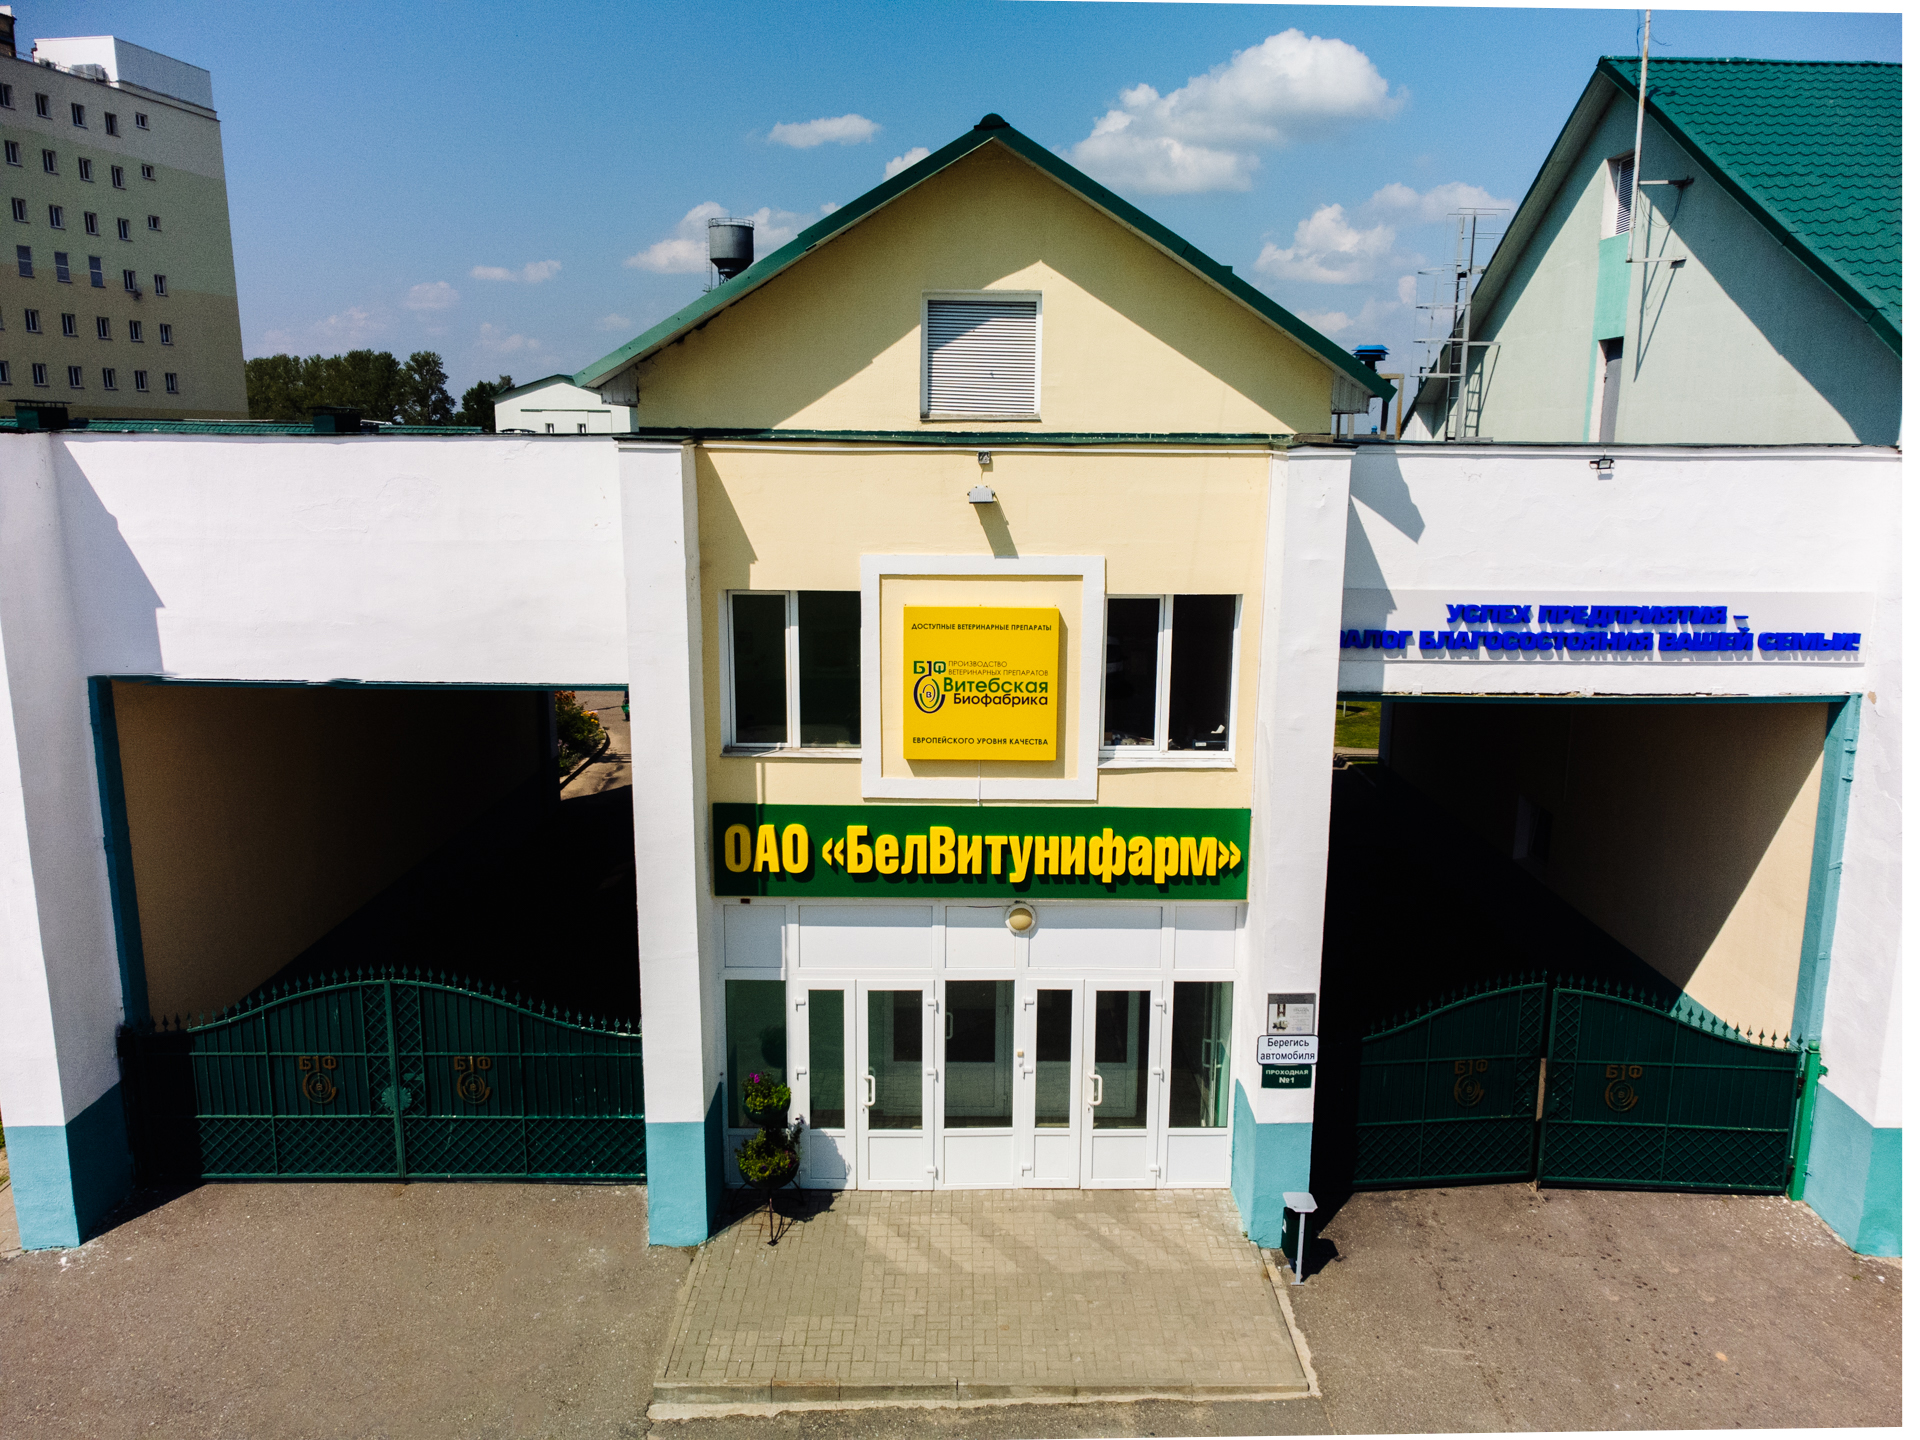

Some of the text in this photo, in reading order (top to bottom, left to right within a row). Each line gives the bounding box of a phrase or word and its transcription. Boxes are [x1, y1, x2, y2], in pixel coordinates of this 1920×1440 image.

[1446, 604, 1532, 624] УСПЕХ
[1538, 605, 1728, 628] ПРЕДПРИЯТИЯ
[957, 623, 1009, 631] ВЕТЕРИНАРНЫЕ
[1419, 630, 1654, 651] БЛАГОСОСТОЯНИЯ
[1658, 627, 1754, 651] ВАШЕЙ
[948, 660, 1008, 668] ПРОИЗВОДСТВО
[943, 676, 1048, 693] Витебская
[953, 693, 1048, 707] Биофабрика
[912, 736, 975, 744] ЕВРОПЕЙСКОГО
[724, 823, 1242, 884] ОАО «БелВитунифарм»
[1267, 1038, 1310, 1048] Берегись
[1260, 1051, 1315, 1060] автомобиля
